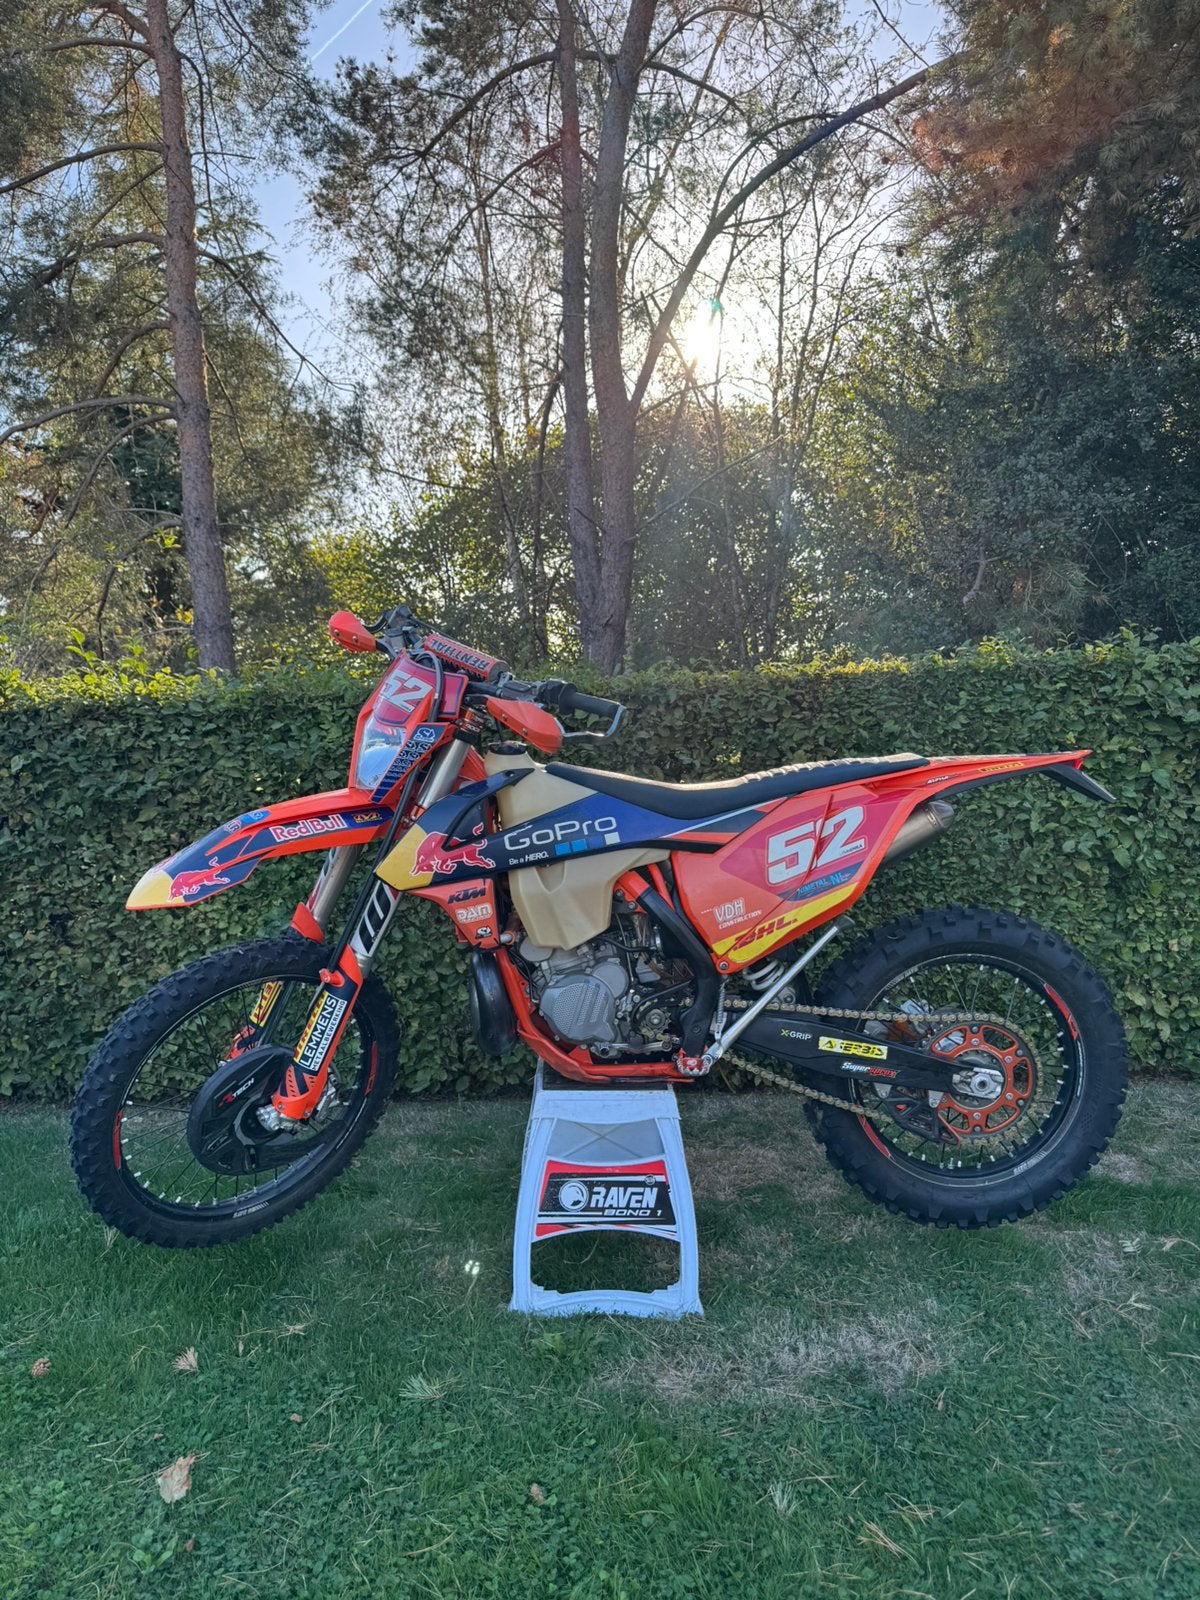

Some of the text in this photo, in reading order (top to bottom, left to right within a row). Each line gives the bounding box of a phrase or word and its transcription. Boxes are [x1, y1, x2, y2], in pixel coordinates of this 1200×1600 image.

[430, 638, 491, 670] RENTHAL
[269, 819, 311, 843] Red
[309, 813, 347, 834] Bull
[503, 816, 618, 851] GoPro
[767, 805, 866, 885] 52
[508, 857, 520, 866] Be
[447, 886, 487, 905] KTM
[714, 898, 745, 923] VDH
[733, 917, 798, 951] DHL
[300, 996, 337, 1067] LEMMENS
[311, 1000, 346, 1071] METAALBEWERKING
[780, 1028, 813, 1041] X-GRIP
[589, 1186, 659, 1208] RAVEN
[656, 1209, 663, 1217] 1
